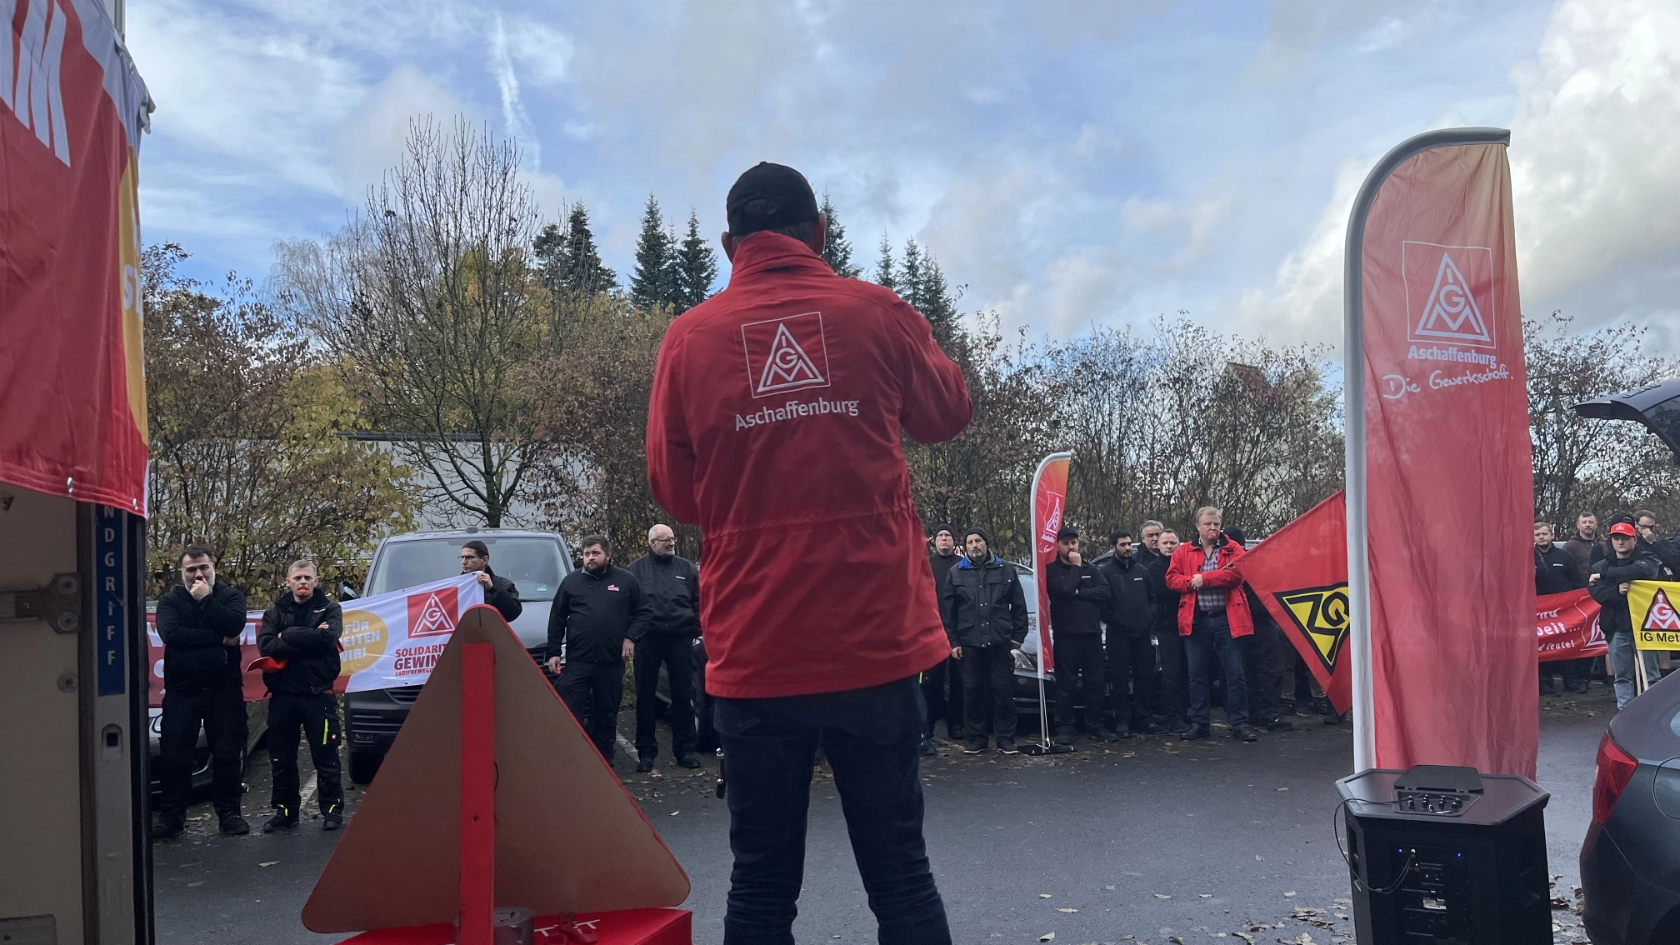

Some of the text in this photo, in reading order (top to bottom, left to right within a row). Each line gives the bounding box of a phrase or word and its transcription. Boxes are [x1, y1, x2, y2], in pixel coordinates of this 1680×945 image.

[1408, 345, 1497, 369] Aschaffenburg
[1382, 374, 1421, 399] Die
[735, 397, 860, 431] Aschaffenburg
[342, 620, 370, 635] FÜR
[1640, 632, 1653, 642] IG
[340, 630, 381, 648] EITEN
